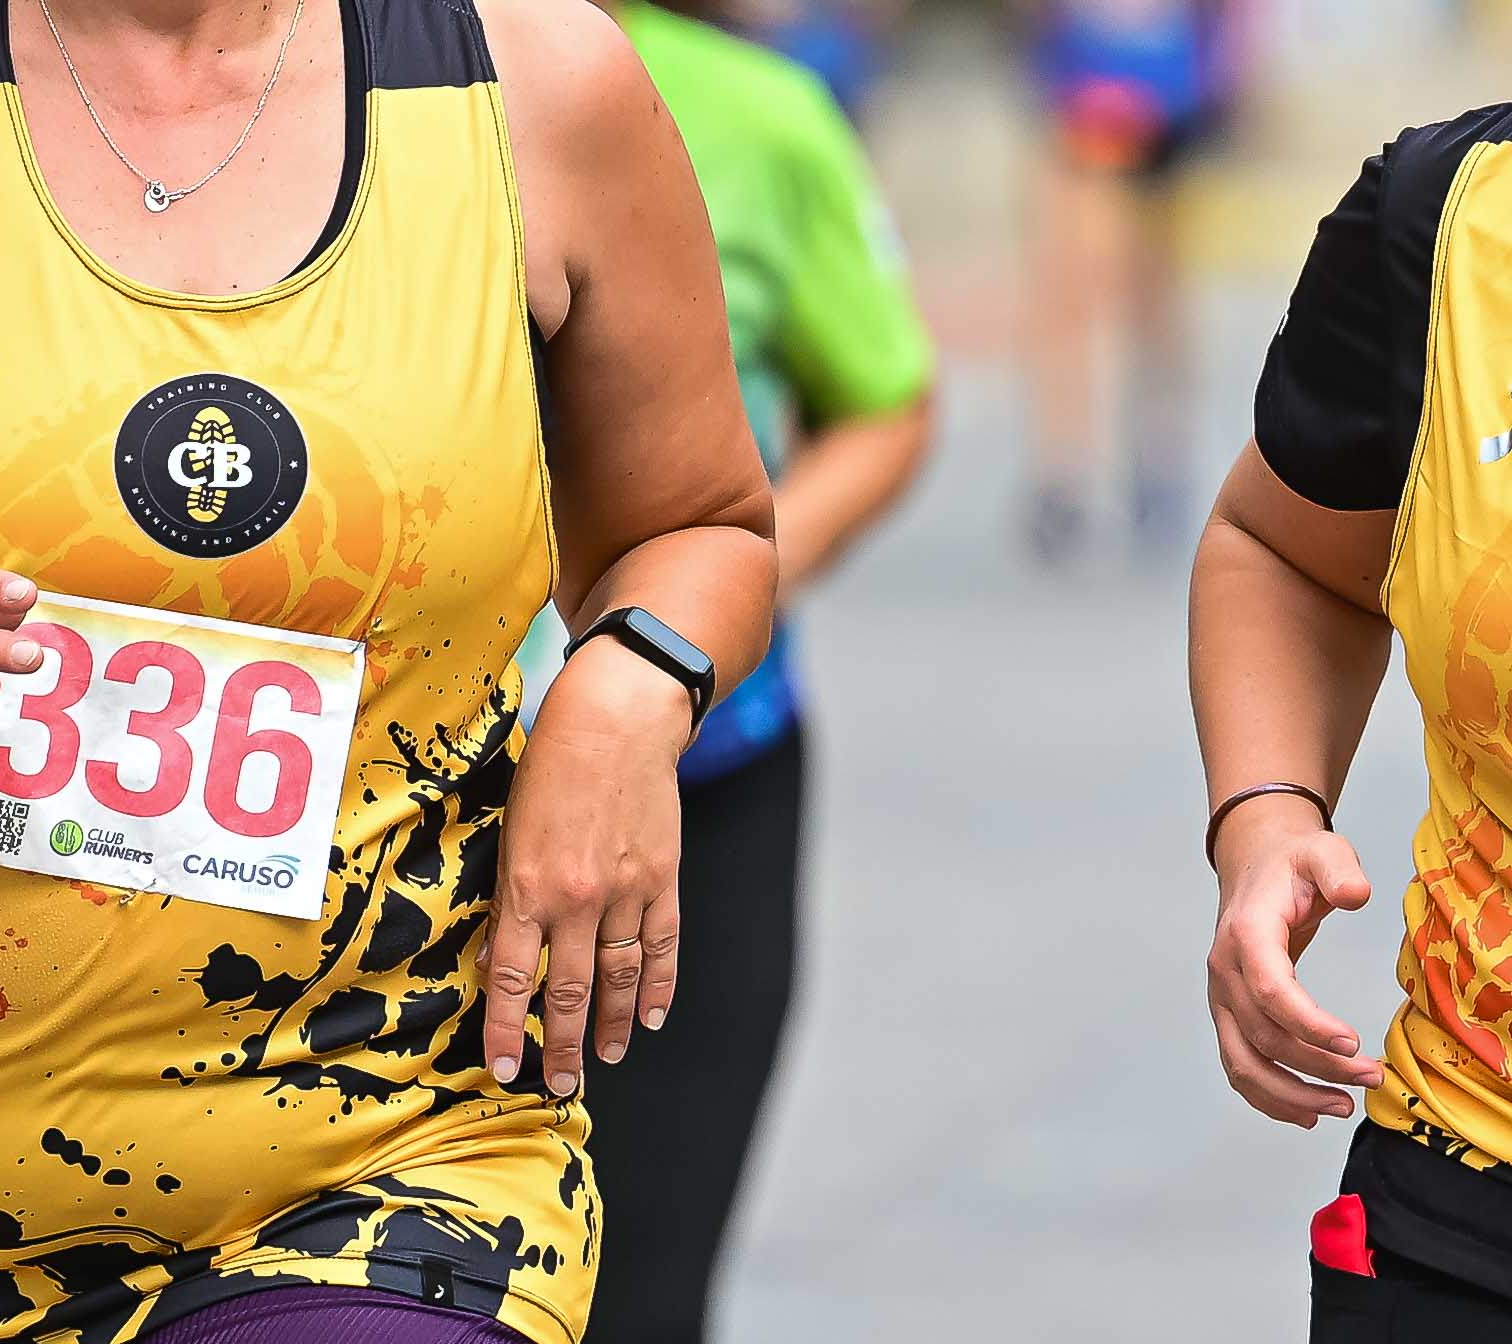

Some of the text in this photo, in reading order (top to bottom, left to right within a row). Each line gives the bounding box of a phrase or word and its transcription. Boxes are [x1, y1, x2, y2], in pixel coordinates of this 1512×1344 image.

[147, 382, 281, 420] TRAINING CLUB
[167, 441, 253, 488] CB
[131, 487, 287, 546] RUNNING AND TRAIL
[83, 841, 154, 865] RUNNER'S
[87, 828, 125, 845] CLUB
[182, 854, 294, 889] CARUSO
